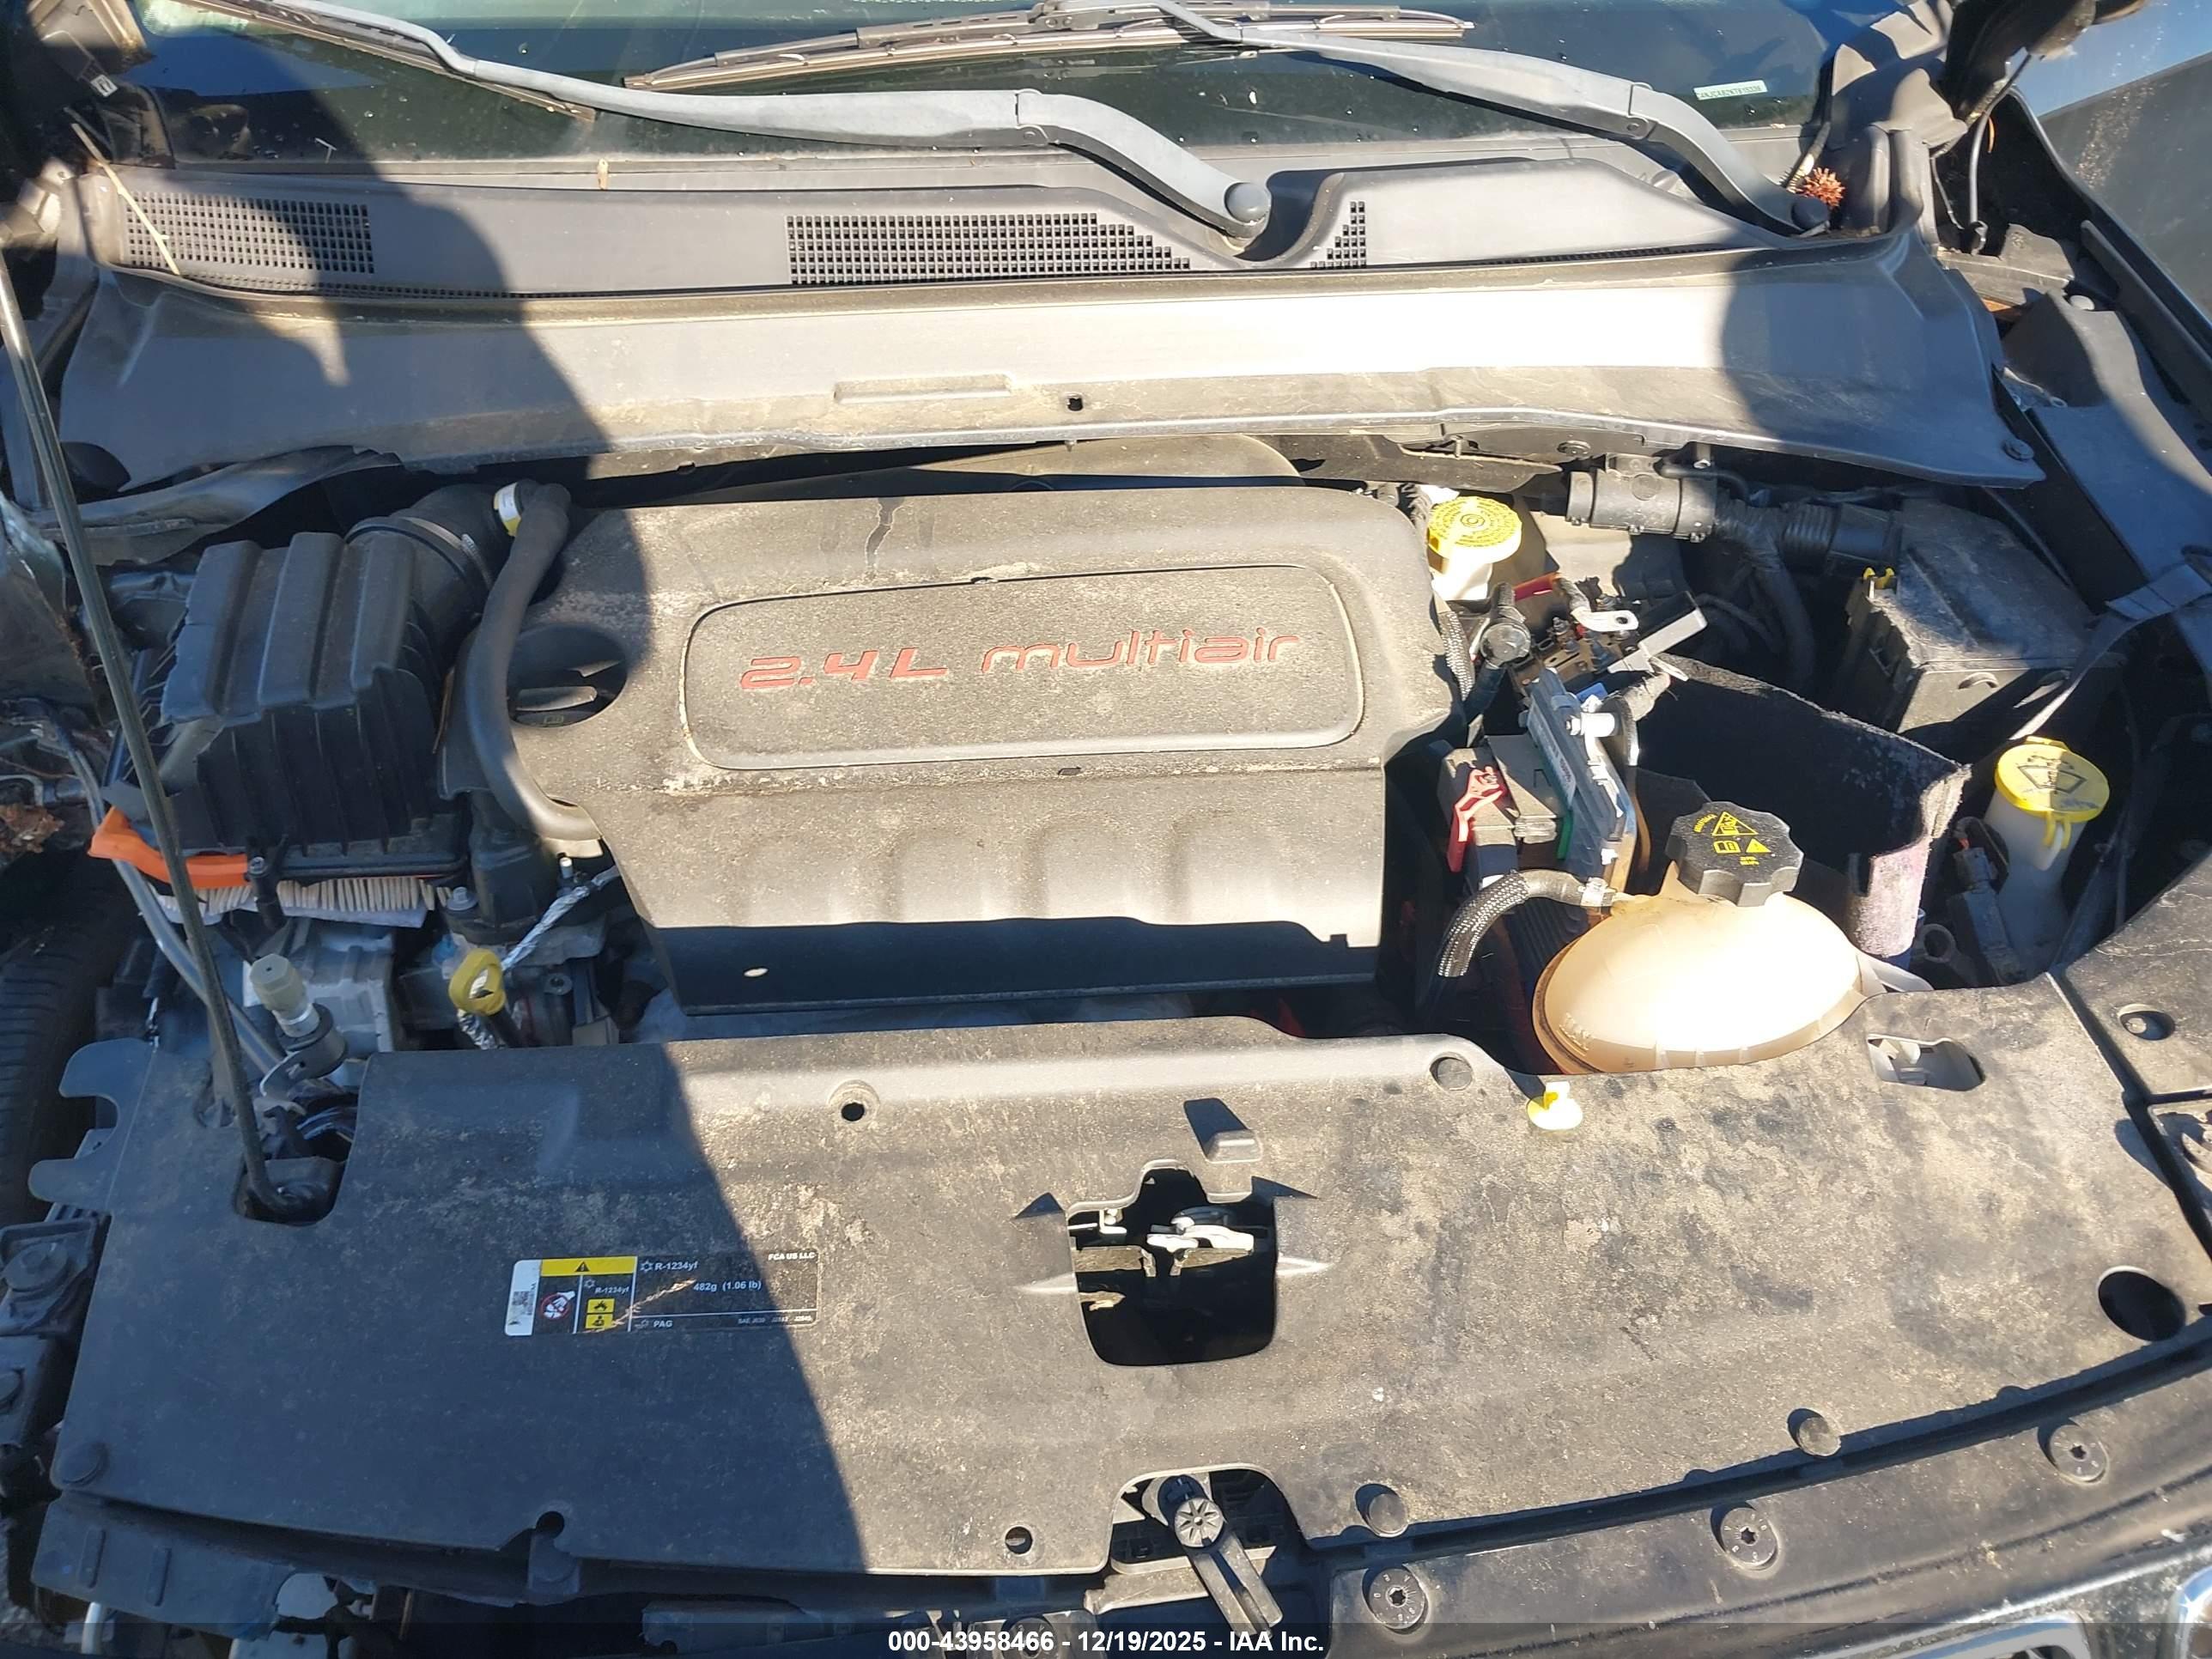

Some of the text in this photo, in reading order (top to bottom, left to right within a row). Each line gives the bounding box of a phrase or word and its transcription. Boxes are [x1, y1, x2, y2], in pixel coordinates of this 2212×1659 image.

[740, 627, 1298, 688] 2.4L multiair
[654, 1261, 697, 1271] R-1234yf
[694, 1280, 762, 1292] 482g (1.06 lb)
[653, 1320, 673, 1328] PAG
